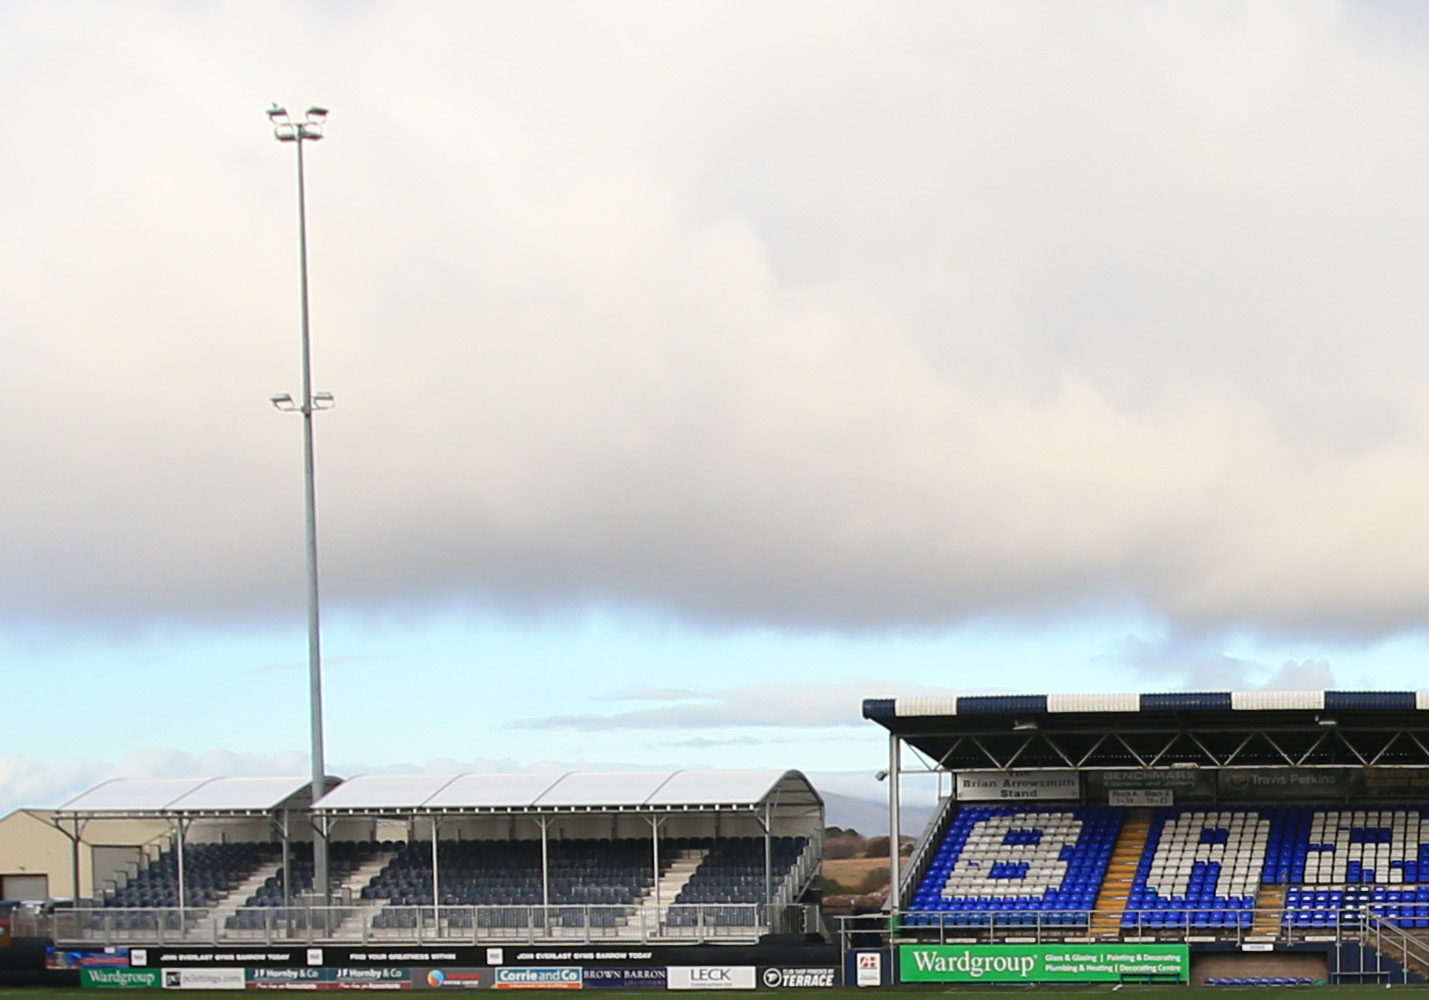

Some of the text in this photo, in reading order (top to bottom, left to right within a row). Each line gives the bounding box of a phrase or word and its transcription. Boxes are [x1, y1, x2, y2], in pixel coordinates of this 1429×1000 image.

[1103, 771, 1196, 780] BENCHMARX
[1252, 774, 1336, 785] Travis Perkins
[962, 779, 1076, 788] Brian Arrowsmith
[1000, 789, 1038, 798] Stand
[595, 952, 627, 960] BARROW
[628, 952, 653, 960] TODAY
[1044, 954, 1182, 963] Glass & Glazing Painting & Decorating
[912, 950, 1037, 977] Wardgroup
[1044, 964, 1181, 973] Plumbing & Heating Decorating Centre
[88, 970, 155, 985] Wardgroup
[253, 968, 319, 979] J F Hornby & Co
[336, 968, 402, 979] J F Hornby & Co
[584, 970, 665, 979] BROWN BARRON
[690, 968, 731, 981] LECK
[782, 974, 834, 987] TERRACE
